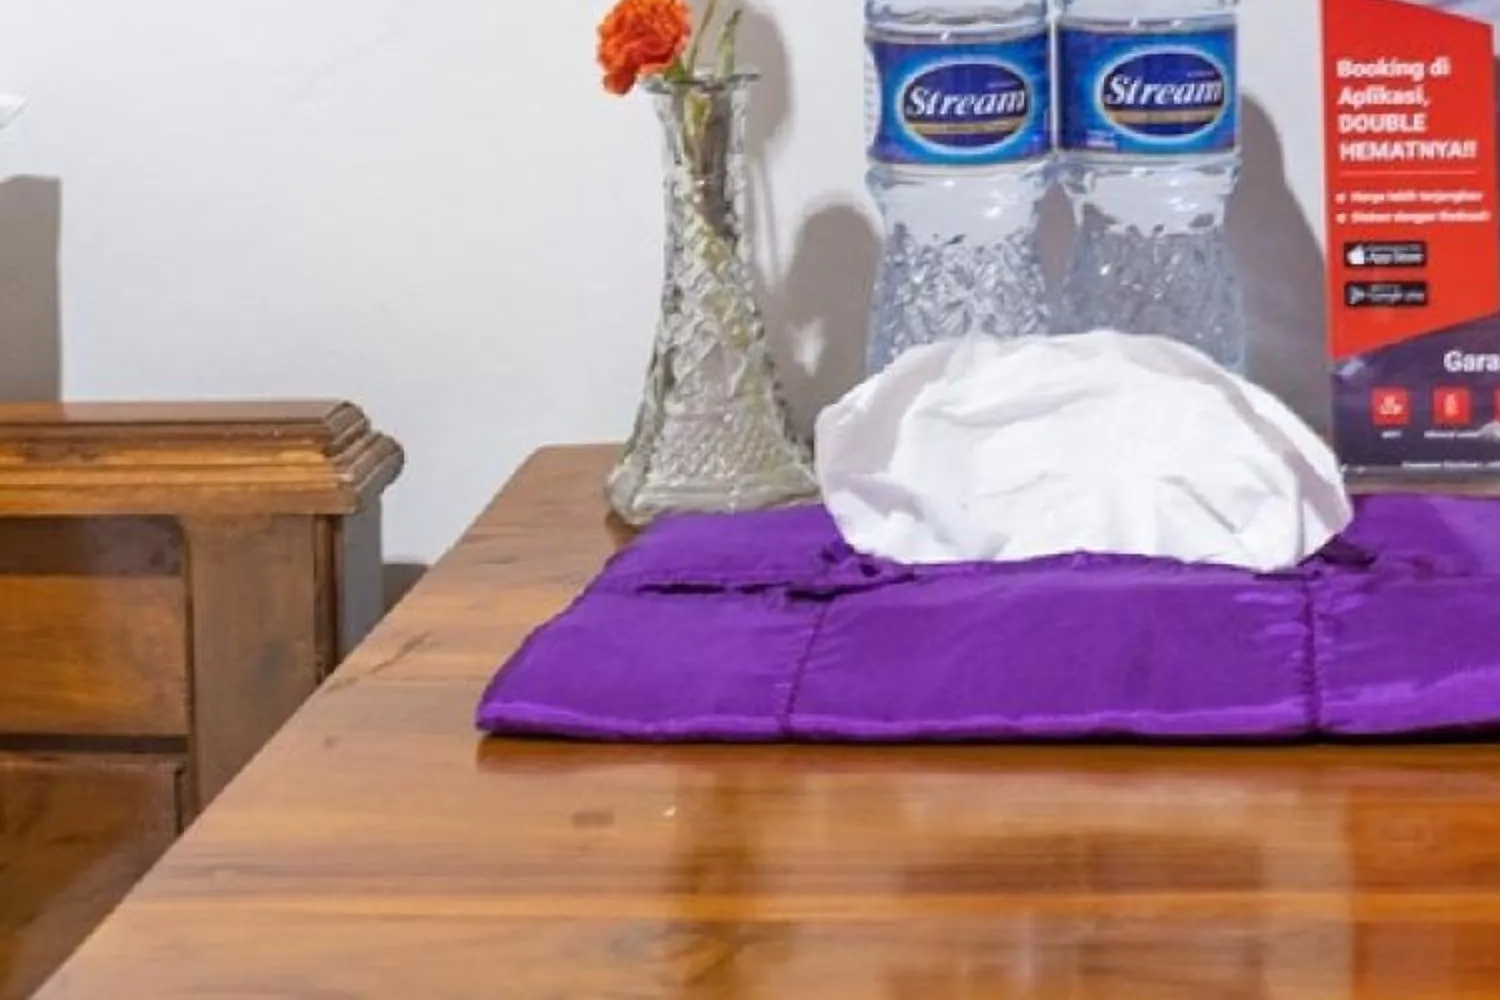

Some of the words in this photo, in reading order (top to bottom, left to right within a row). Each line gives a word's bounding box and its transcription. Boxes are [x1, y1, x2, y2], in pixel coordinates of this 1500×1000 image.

[1336, 59, 1425, 81] Booking
[1429, 56, 1450, 76] di
[907, 85, 1025, 117] Stream
[1108, 75, 1222, 105] Stream
[1337, 85, 1430, 109] Aplikasi,
[1337, 113, 1427, 134] DOUBLE
[1339, 140, 1478, 161] HEMATNYA!!
